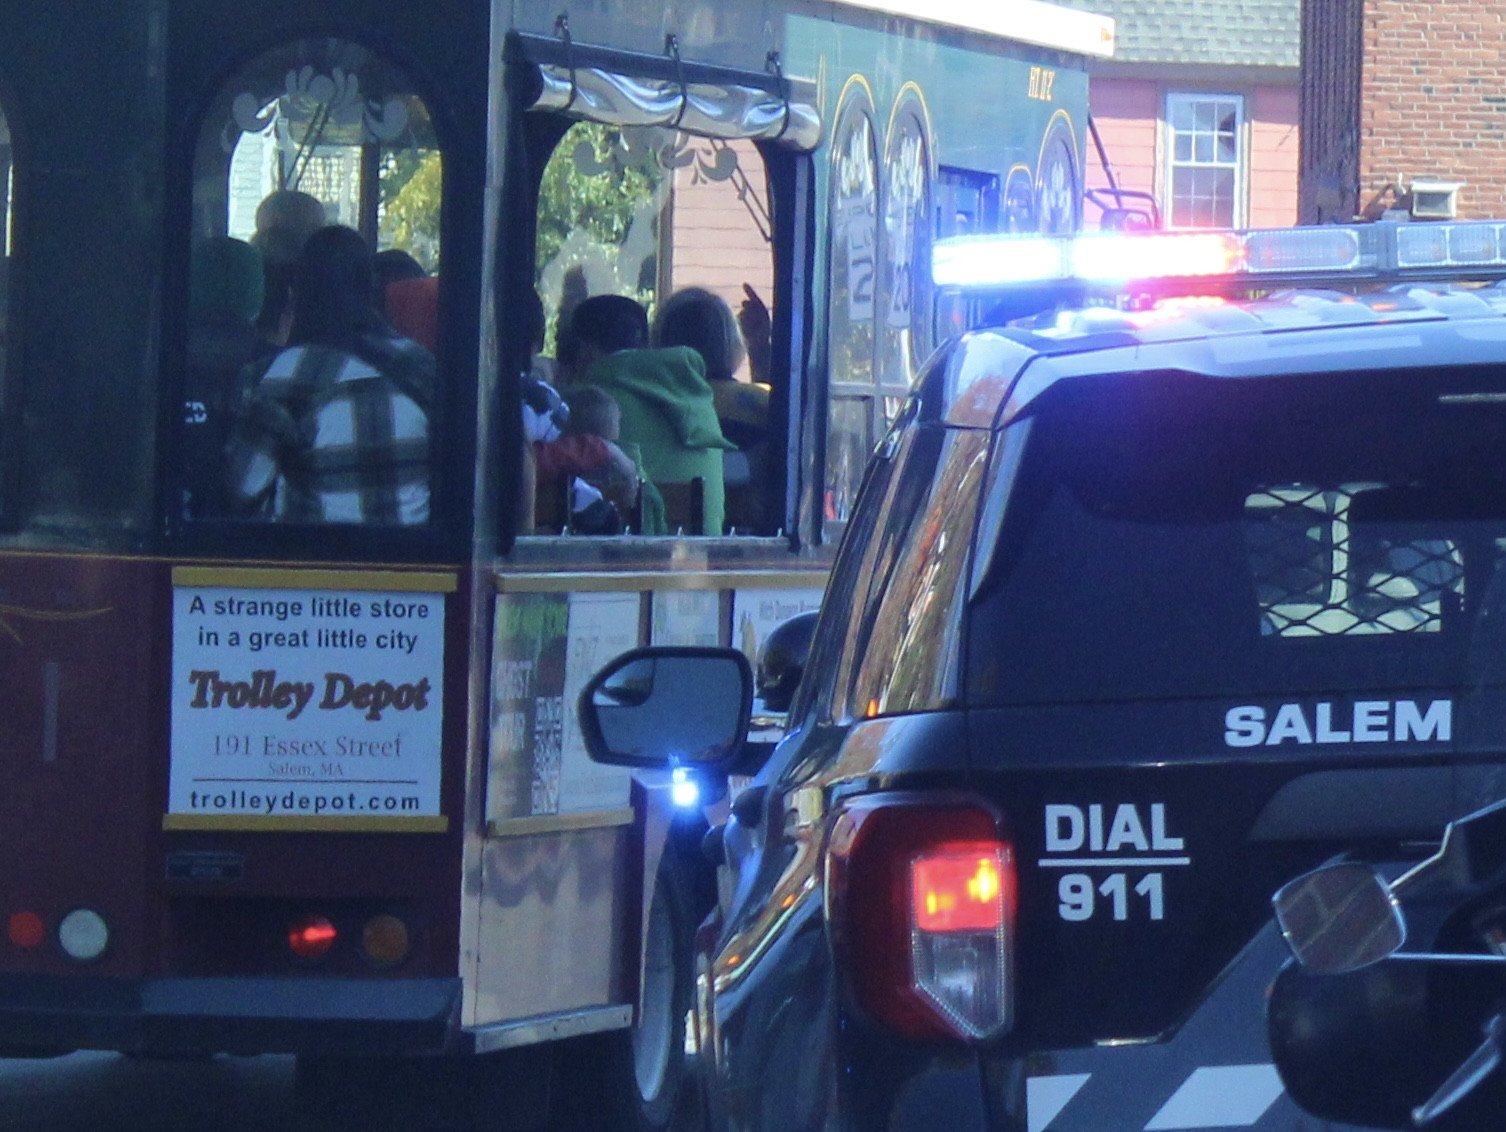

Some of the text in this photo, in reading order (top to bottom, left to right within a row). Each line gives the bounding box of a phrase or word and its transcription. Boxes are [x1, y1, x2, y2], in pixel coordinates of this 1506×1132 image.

[189, 595, 429, 621] A strange little store
[198, 626, 418, 653] in a great little city
[189, 669, 432, 721] Trolley Depot
[1225, 700, 1452, 748] SALEM
[213, 734, 403, 758] 191 Essex Street
[320, 762, 344, 776] MA
[190, 790, 420, 813] trolleydepot.com
[1045, 803, 1184, 852] DIAL
[1058, 873, 1164, 921] 911
